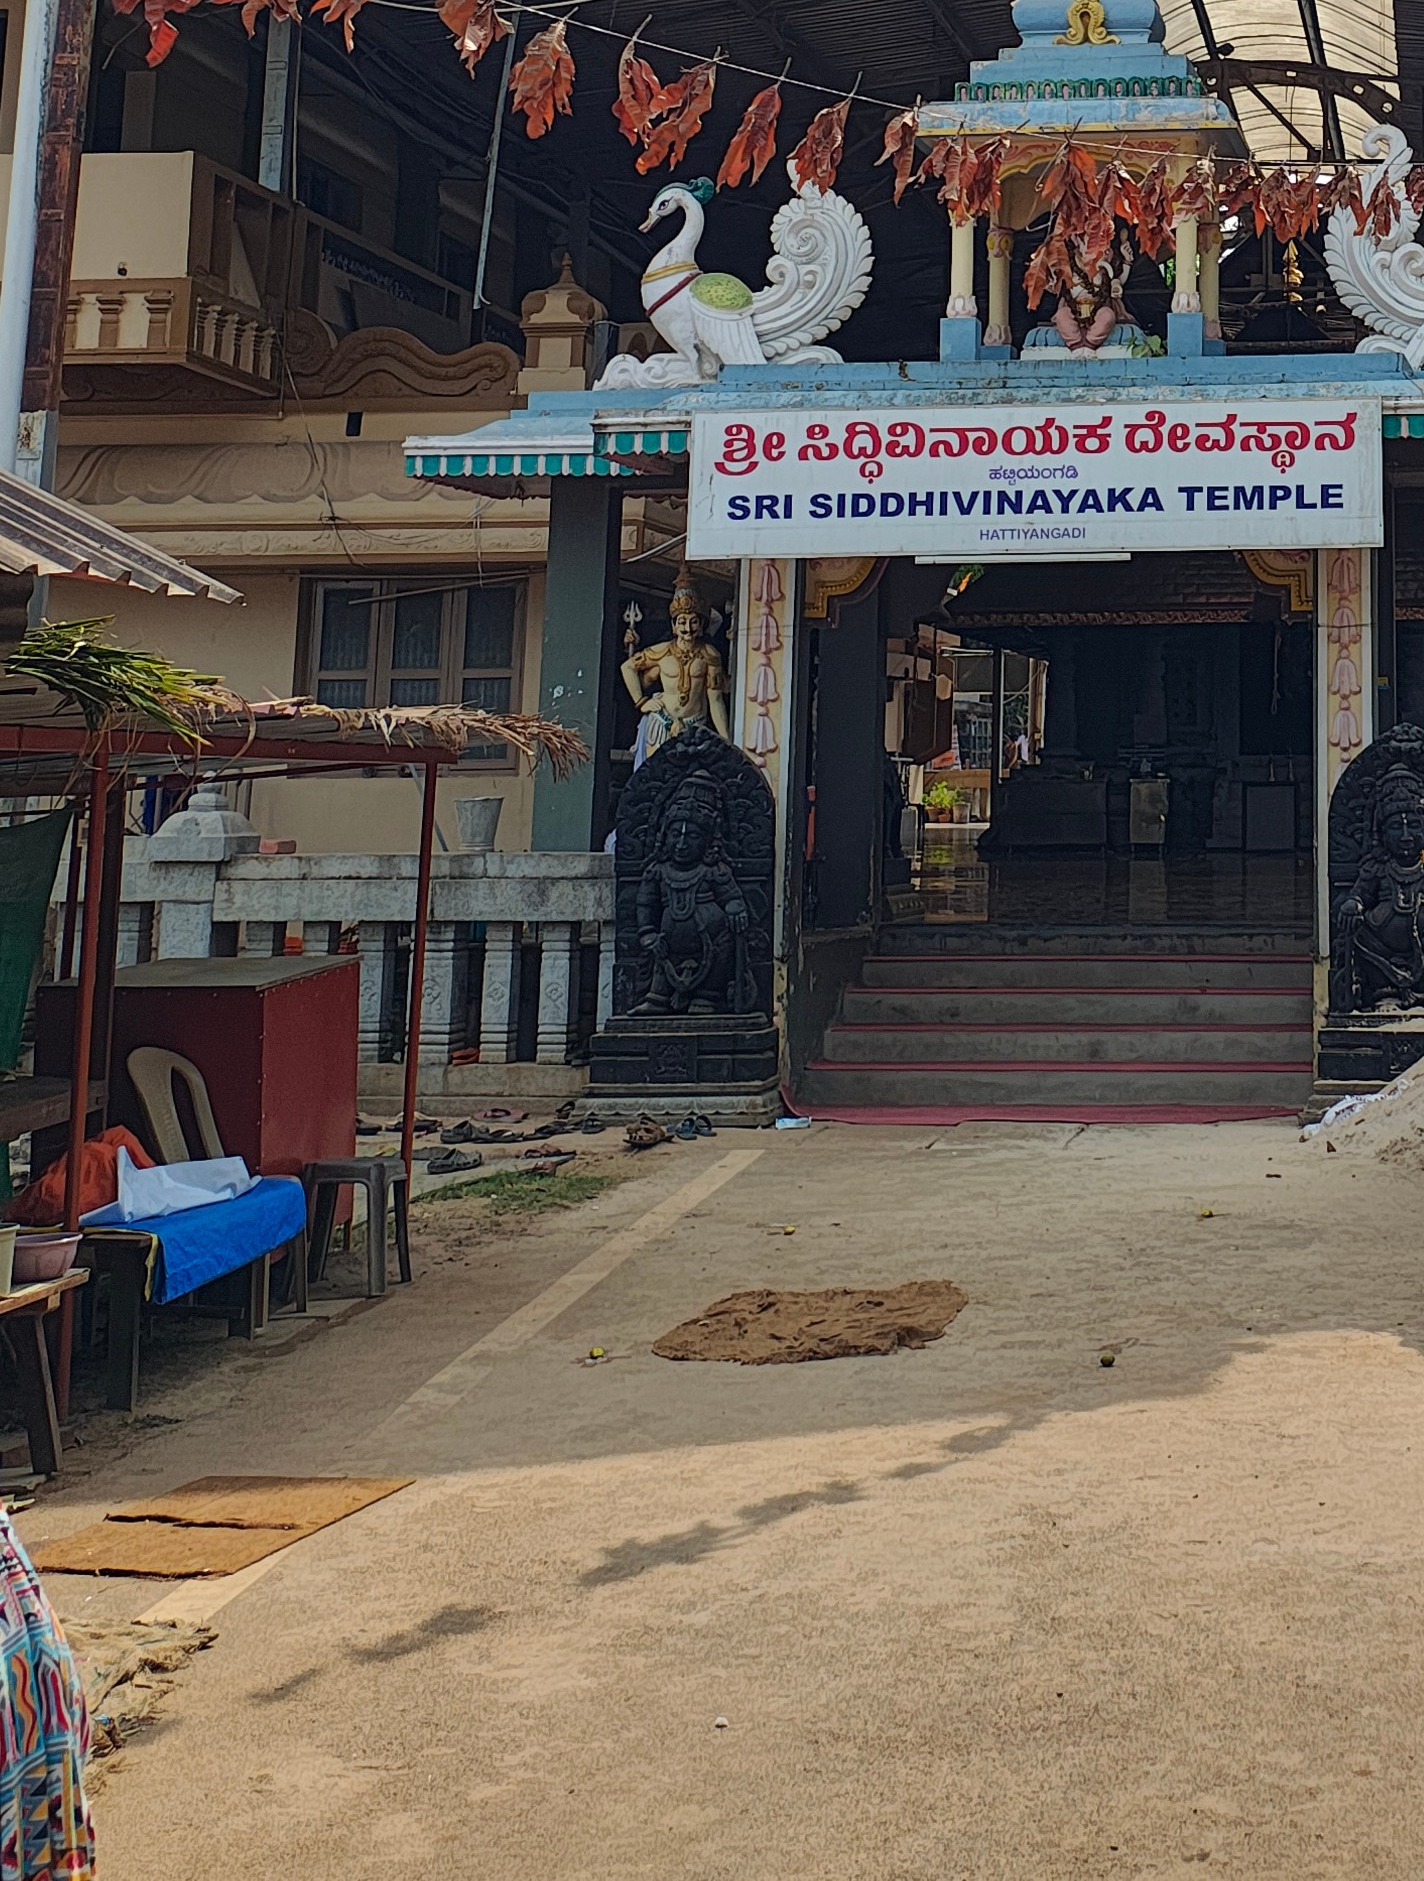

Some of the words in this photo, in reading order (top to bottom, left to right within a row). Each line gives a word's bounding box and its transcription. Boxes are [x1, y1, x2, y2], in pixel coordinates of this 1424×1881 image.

[714, 422, 787, 477] ಶ್ರೀ
[797, 415, 1113, 484] ಸಿದ್ಧಿವಿನಾಯಕ
[1123, 410, 1358, 473] ದೇವಸ್ಥಾನ
[988, 464, 1080, 487] ಹಟ್ಟಿಯಂಗಡಿ
[726, 494, 793, 520] SRI
[808, 486, 1165, 519] SIDDHIVINAYAKA
[1177, 482, 1345, 512] TEMPLE
[980, 527, 1087, 541] HATTIYANGADI
